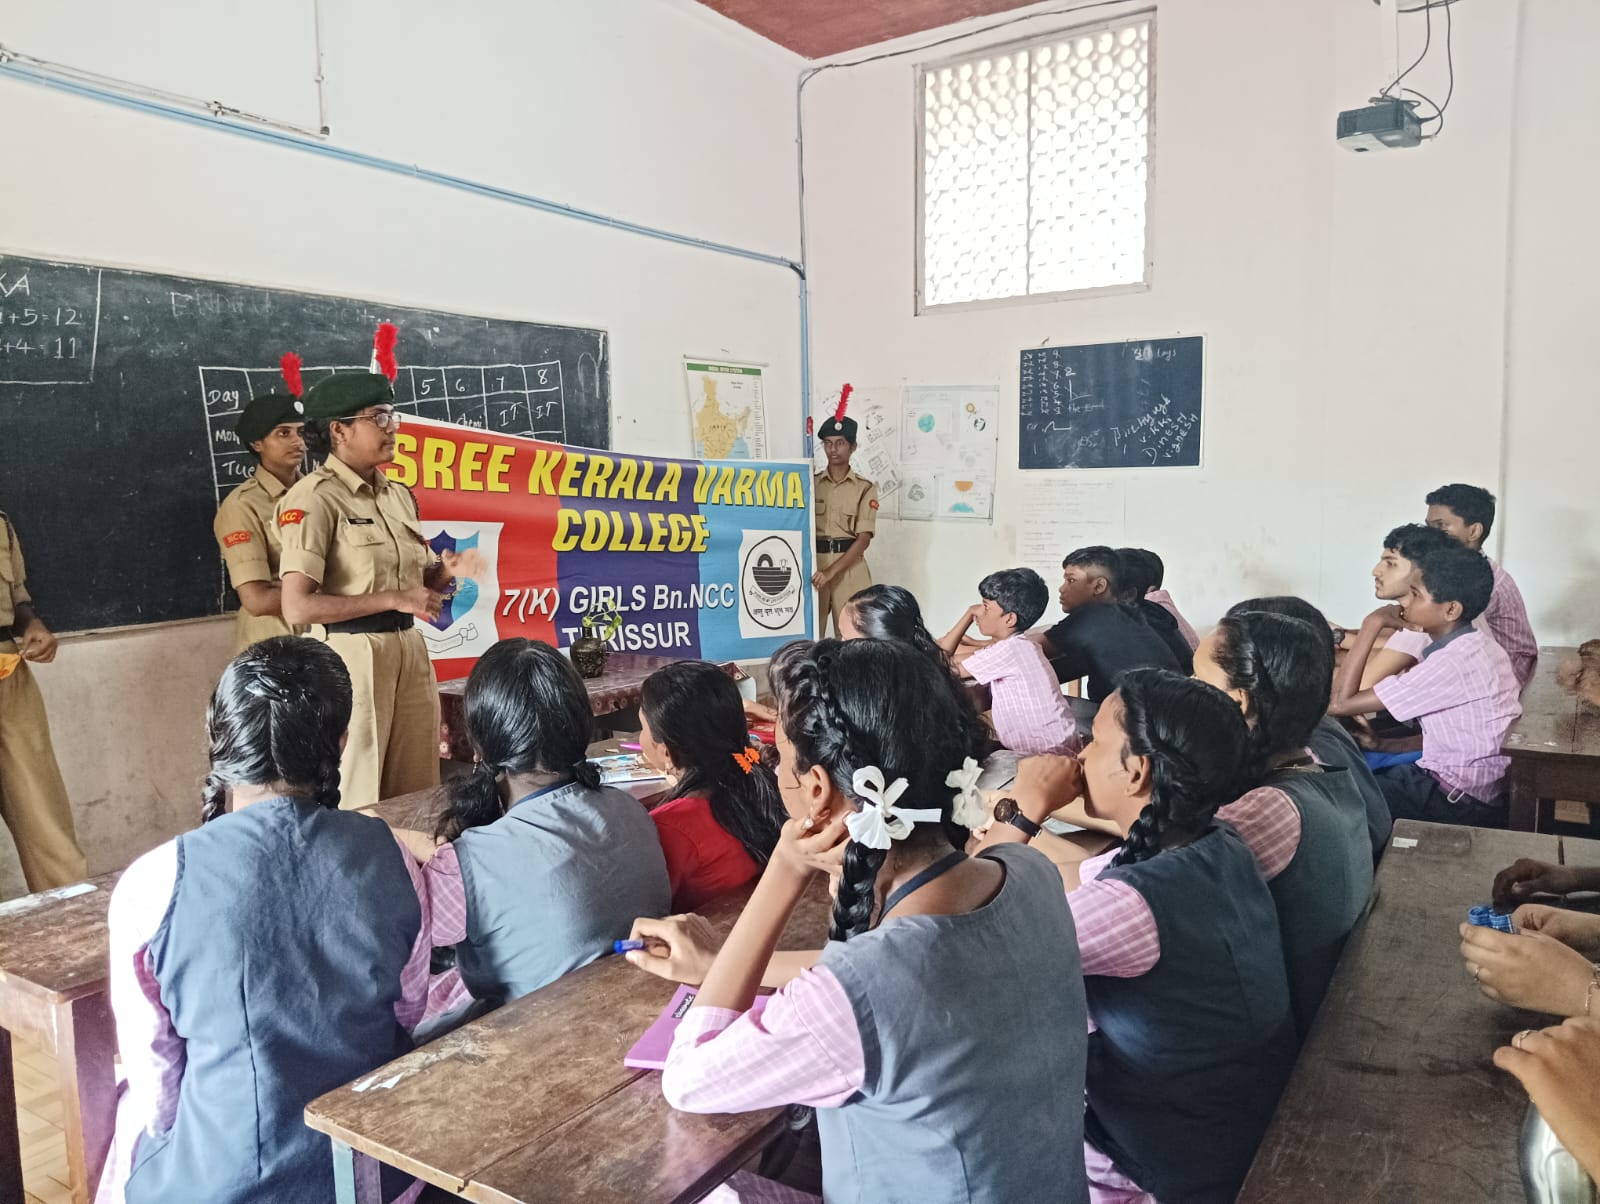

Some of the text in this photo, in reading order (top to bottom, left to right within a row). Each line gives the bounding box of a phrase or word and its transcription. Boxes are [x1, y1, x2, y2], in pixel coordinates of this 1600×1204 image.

[208, 389, 240, 411] Day
[420, 378, 436, 395] 5
[455, 378, 466, 392] 6
[537, 368, 548, 385] 8
[499, 401, 523, 427] IT
[535, 401, 560, 419] IT
[386, 433, 806, 508] SREE KERALA VARMA
[551, 508, 710, 552] COLLEGE
[502, 587, 560, 622] 7(K)
[569, 584, 647, 614] GIRLS
[653, 582, 735, 611] Bn.NCC
